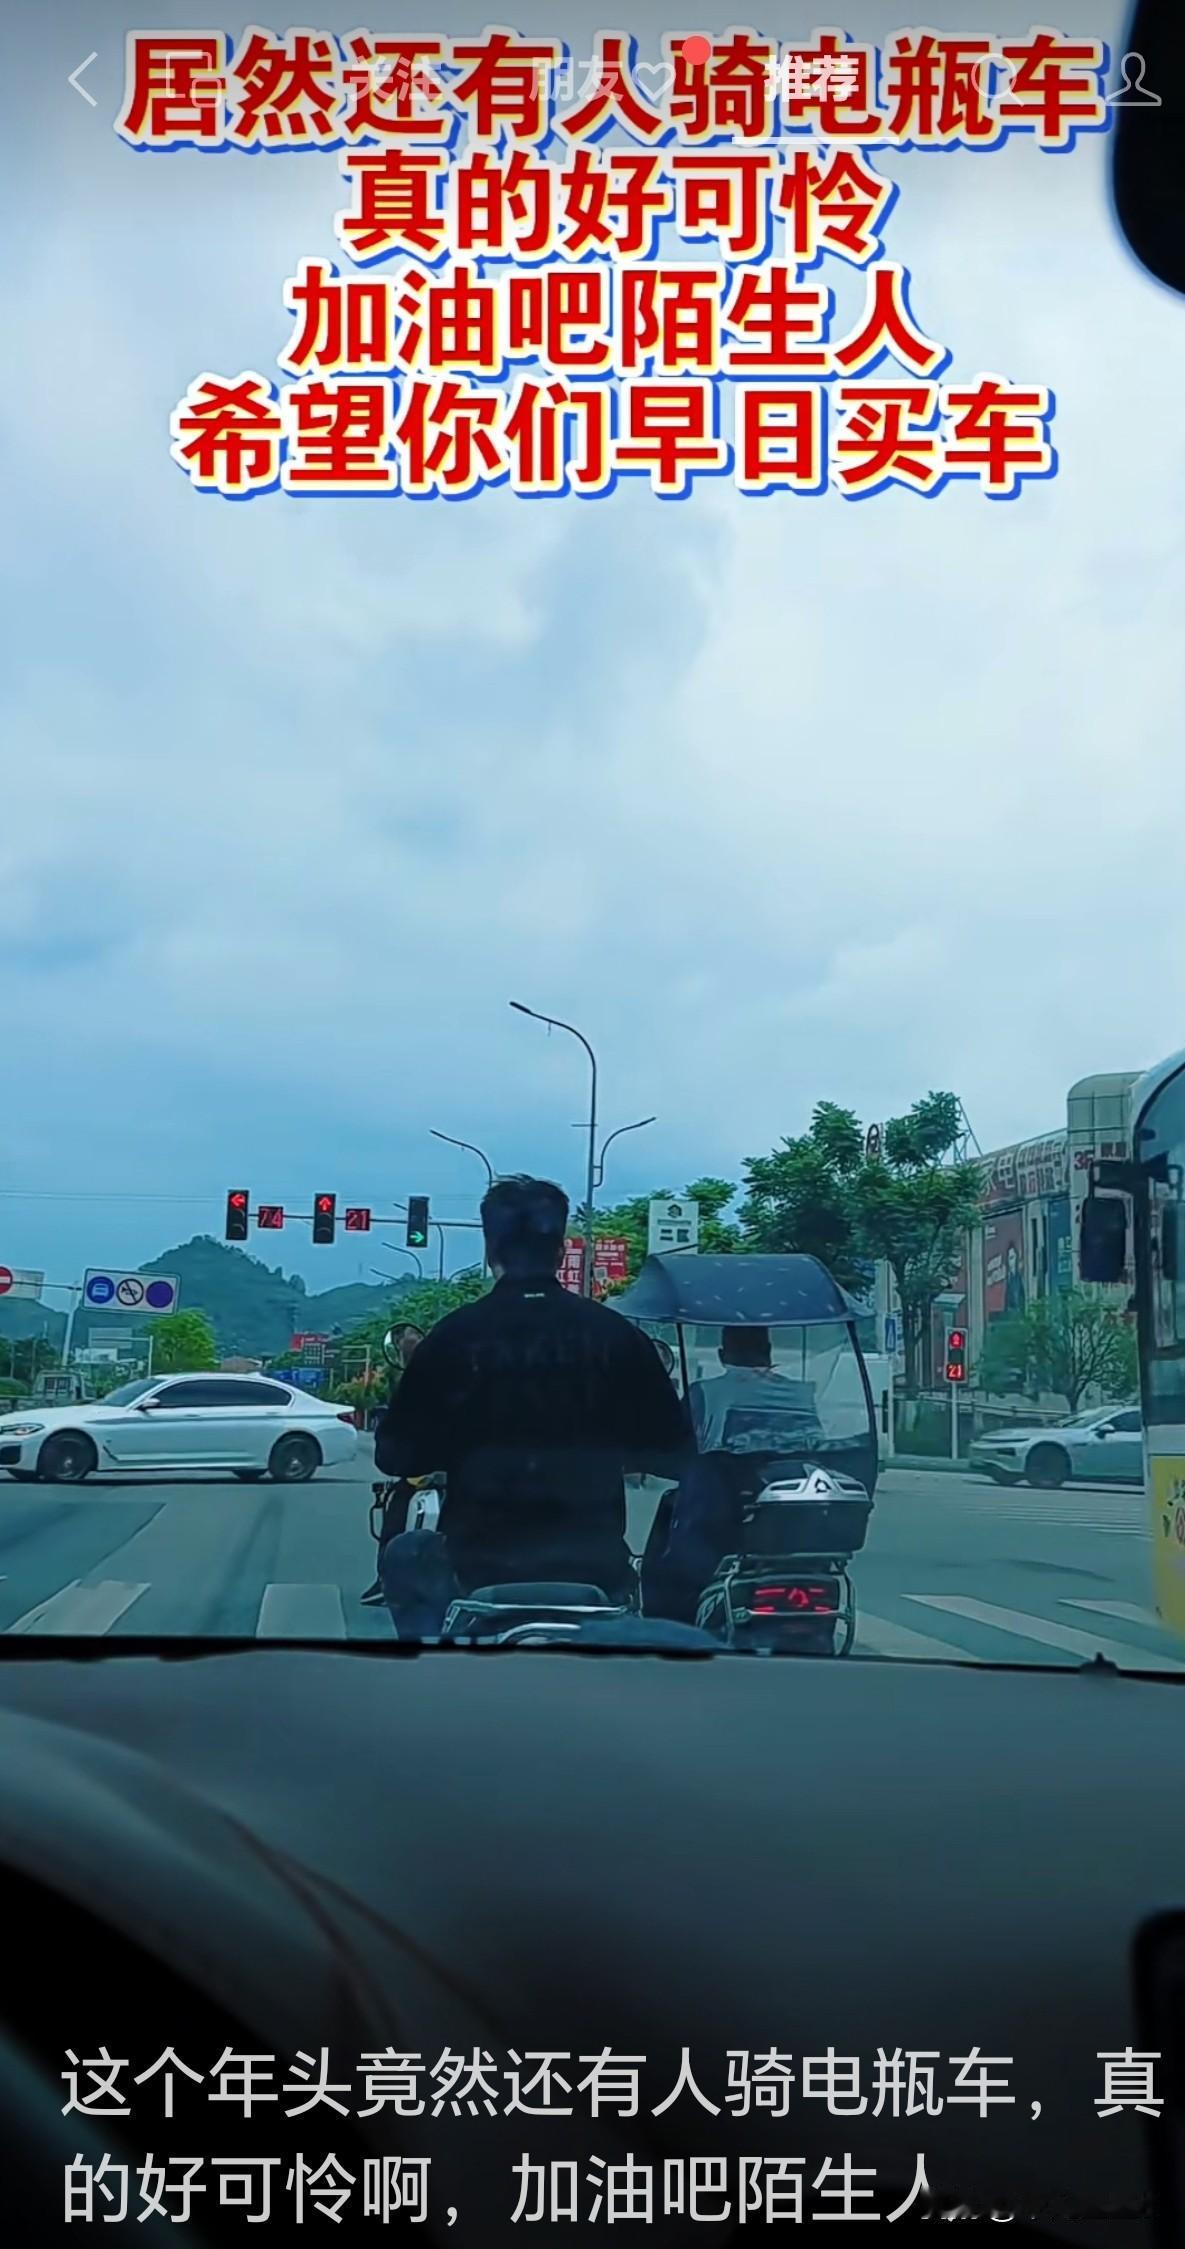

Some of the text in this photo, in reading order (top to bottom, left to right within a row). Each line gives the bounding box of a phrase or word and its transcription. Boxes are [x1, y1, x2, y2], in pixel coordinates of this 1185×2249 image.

[259, 1207, 283, 1228] 74
[346, 1209, 370, 1230] 21
[948, 1364, 963, 1378] 21
